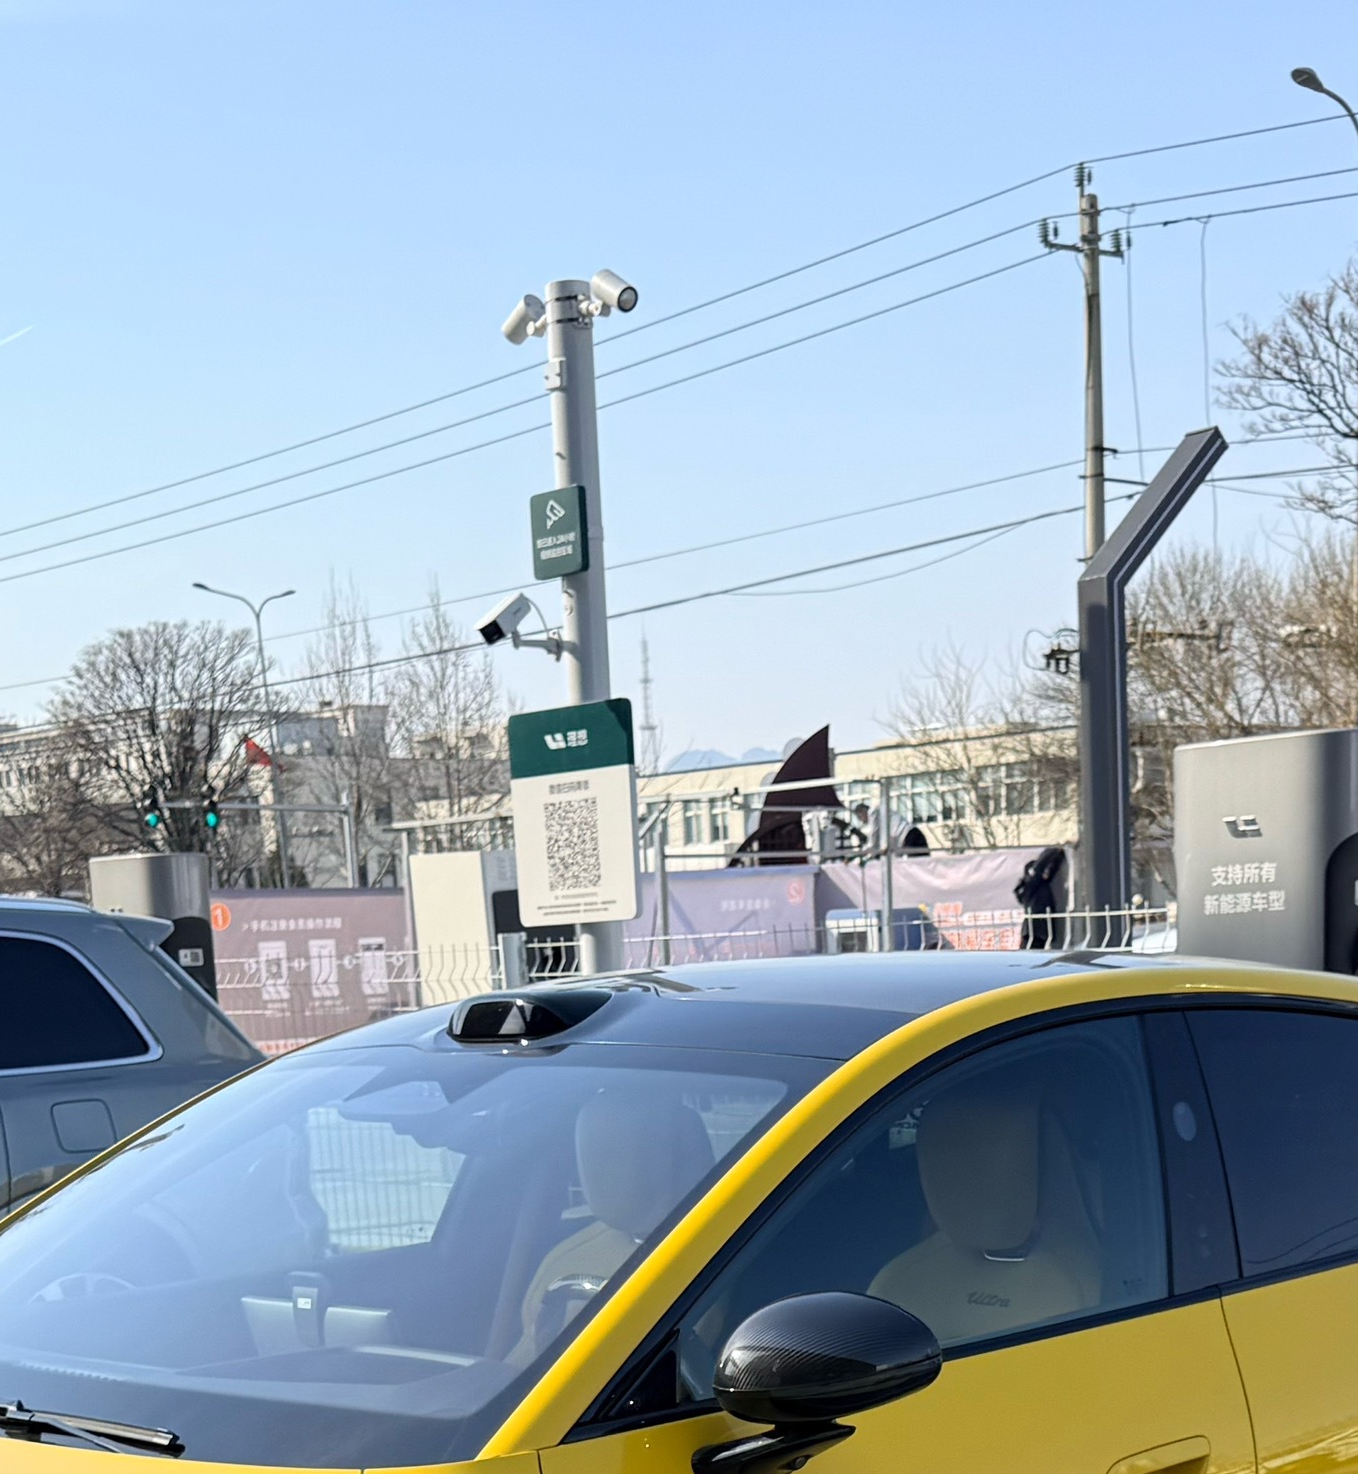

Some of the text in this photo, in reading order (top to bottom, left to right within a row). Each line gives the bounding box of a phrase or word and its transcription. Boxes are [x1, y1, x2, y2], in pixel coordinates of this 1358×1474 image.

[1211, 862, 1277, 886] 支持所有
[1203, 890, 1285, 915] 新能源车型
